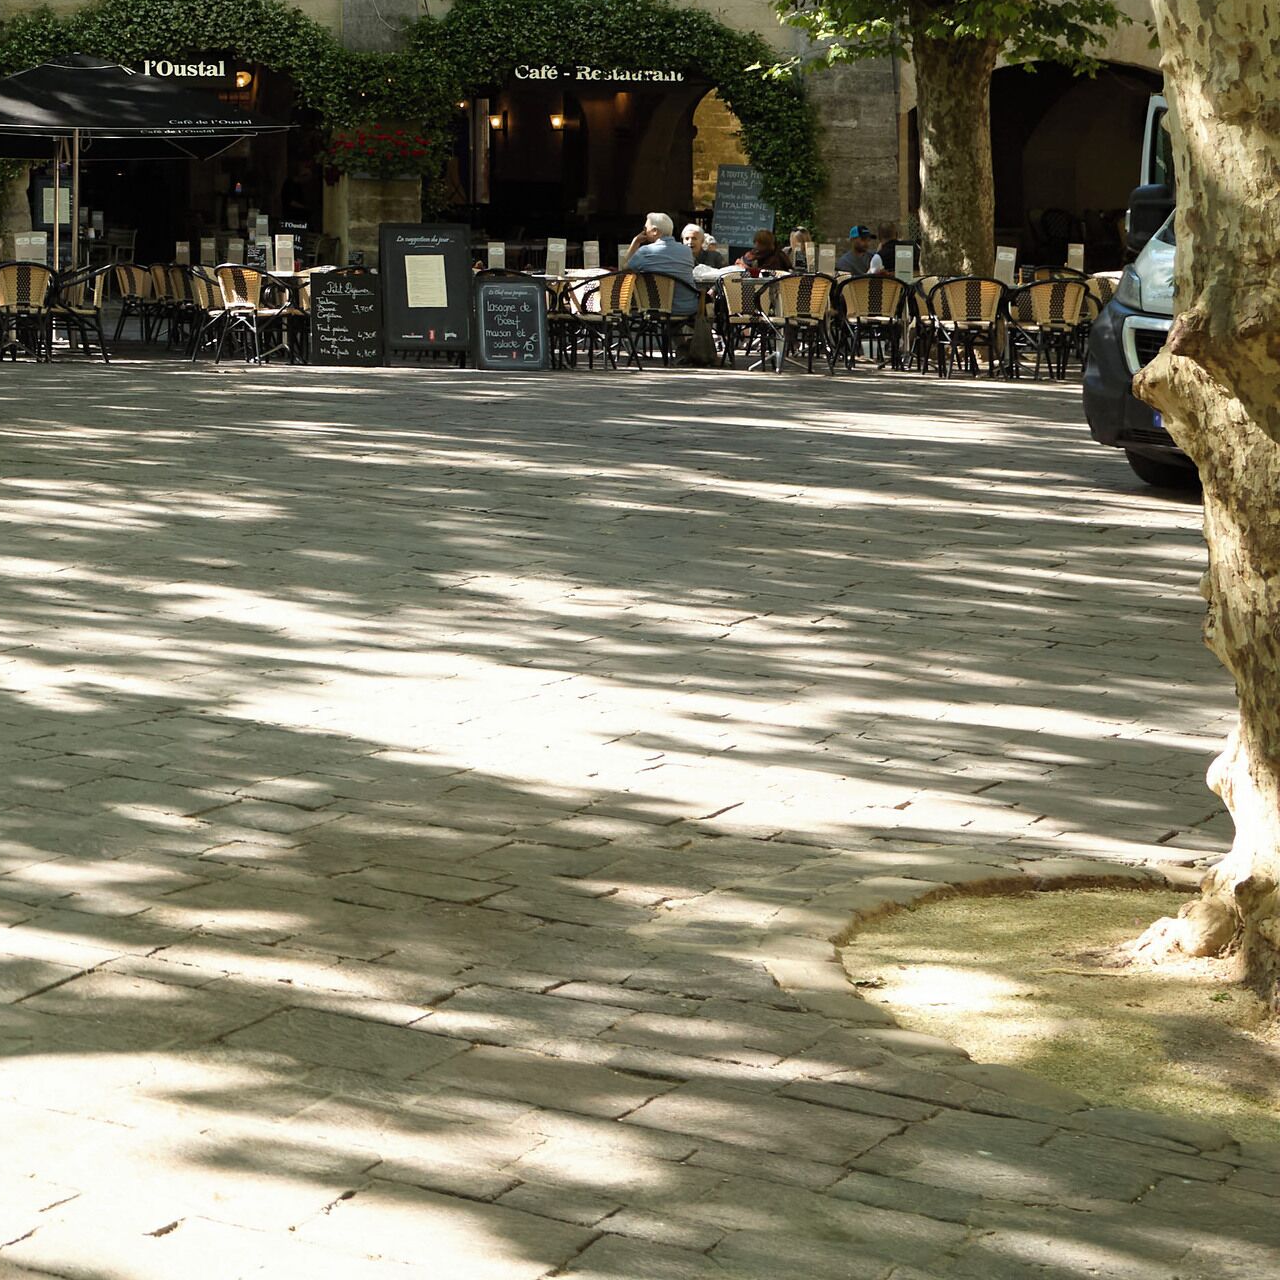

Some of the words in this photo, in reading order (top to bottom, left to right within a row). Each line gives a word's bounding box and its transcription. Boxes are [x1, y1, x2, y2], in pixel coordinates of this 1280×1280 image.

[515, 64, 558, 80] Café
[721, 202, 768, 211] ITALIENNE
[520, 301, 533, 313] de
[486, 329, 512, 338] maison
[517, 327, 526, 338] et
